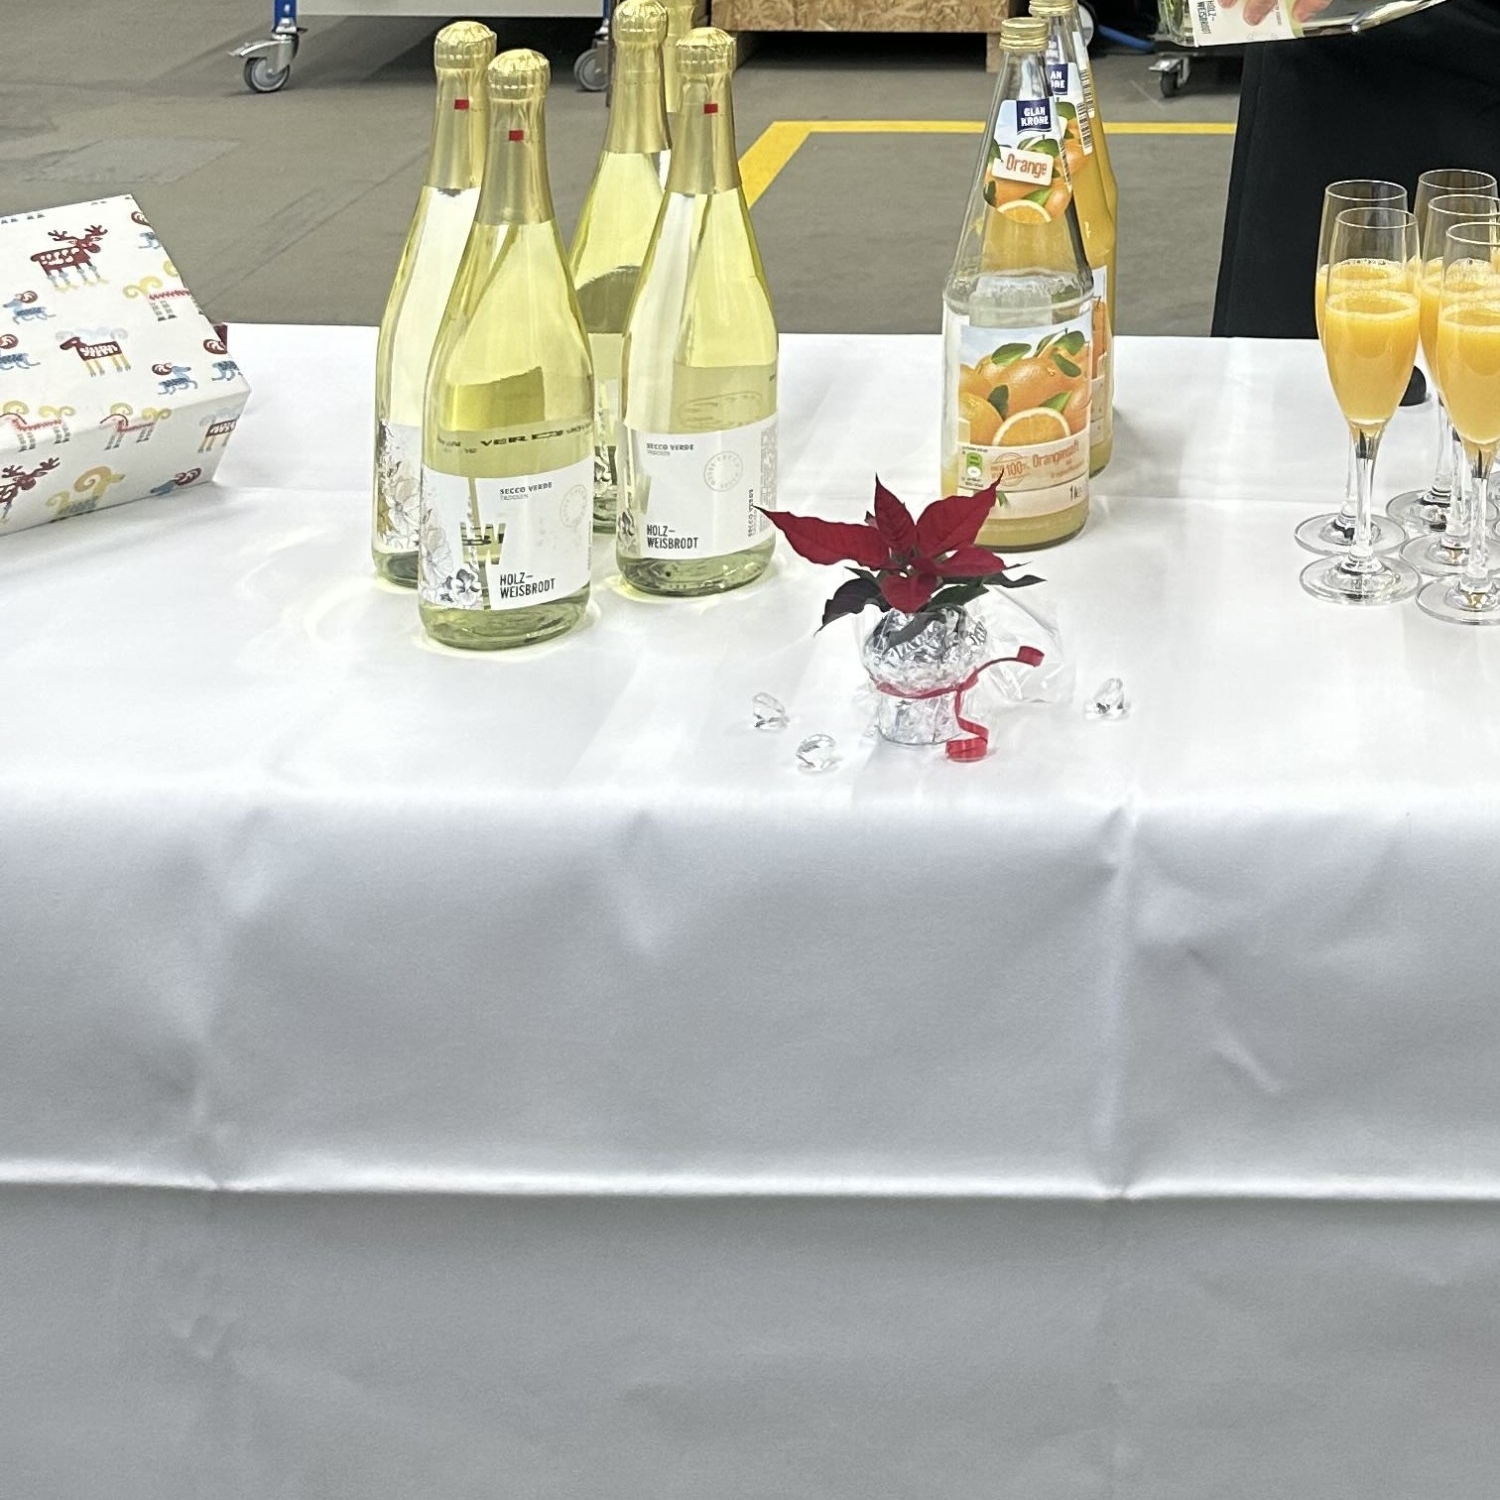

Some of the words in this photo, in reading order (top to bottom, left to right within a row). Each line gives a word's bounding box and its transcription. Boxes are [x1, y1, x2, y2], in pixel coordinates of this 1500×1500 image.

[1023, 106, 1046, 117] GLAN
[1020, 115, 1049, 128] KRONE
[1006, 153, 1048, 179] Orange
[499, 486, 526, 495] SECCO
[646, 524, 676, 538] HOLZ-
[646, 536, 699, 550] WEISBRODT
[500, 571, 534, 586] HOLZ-
[500, 577, 556, 599] WEISBRODT
